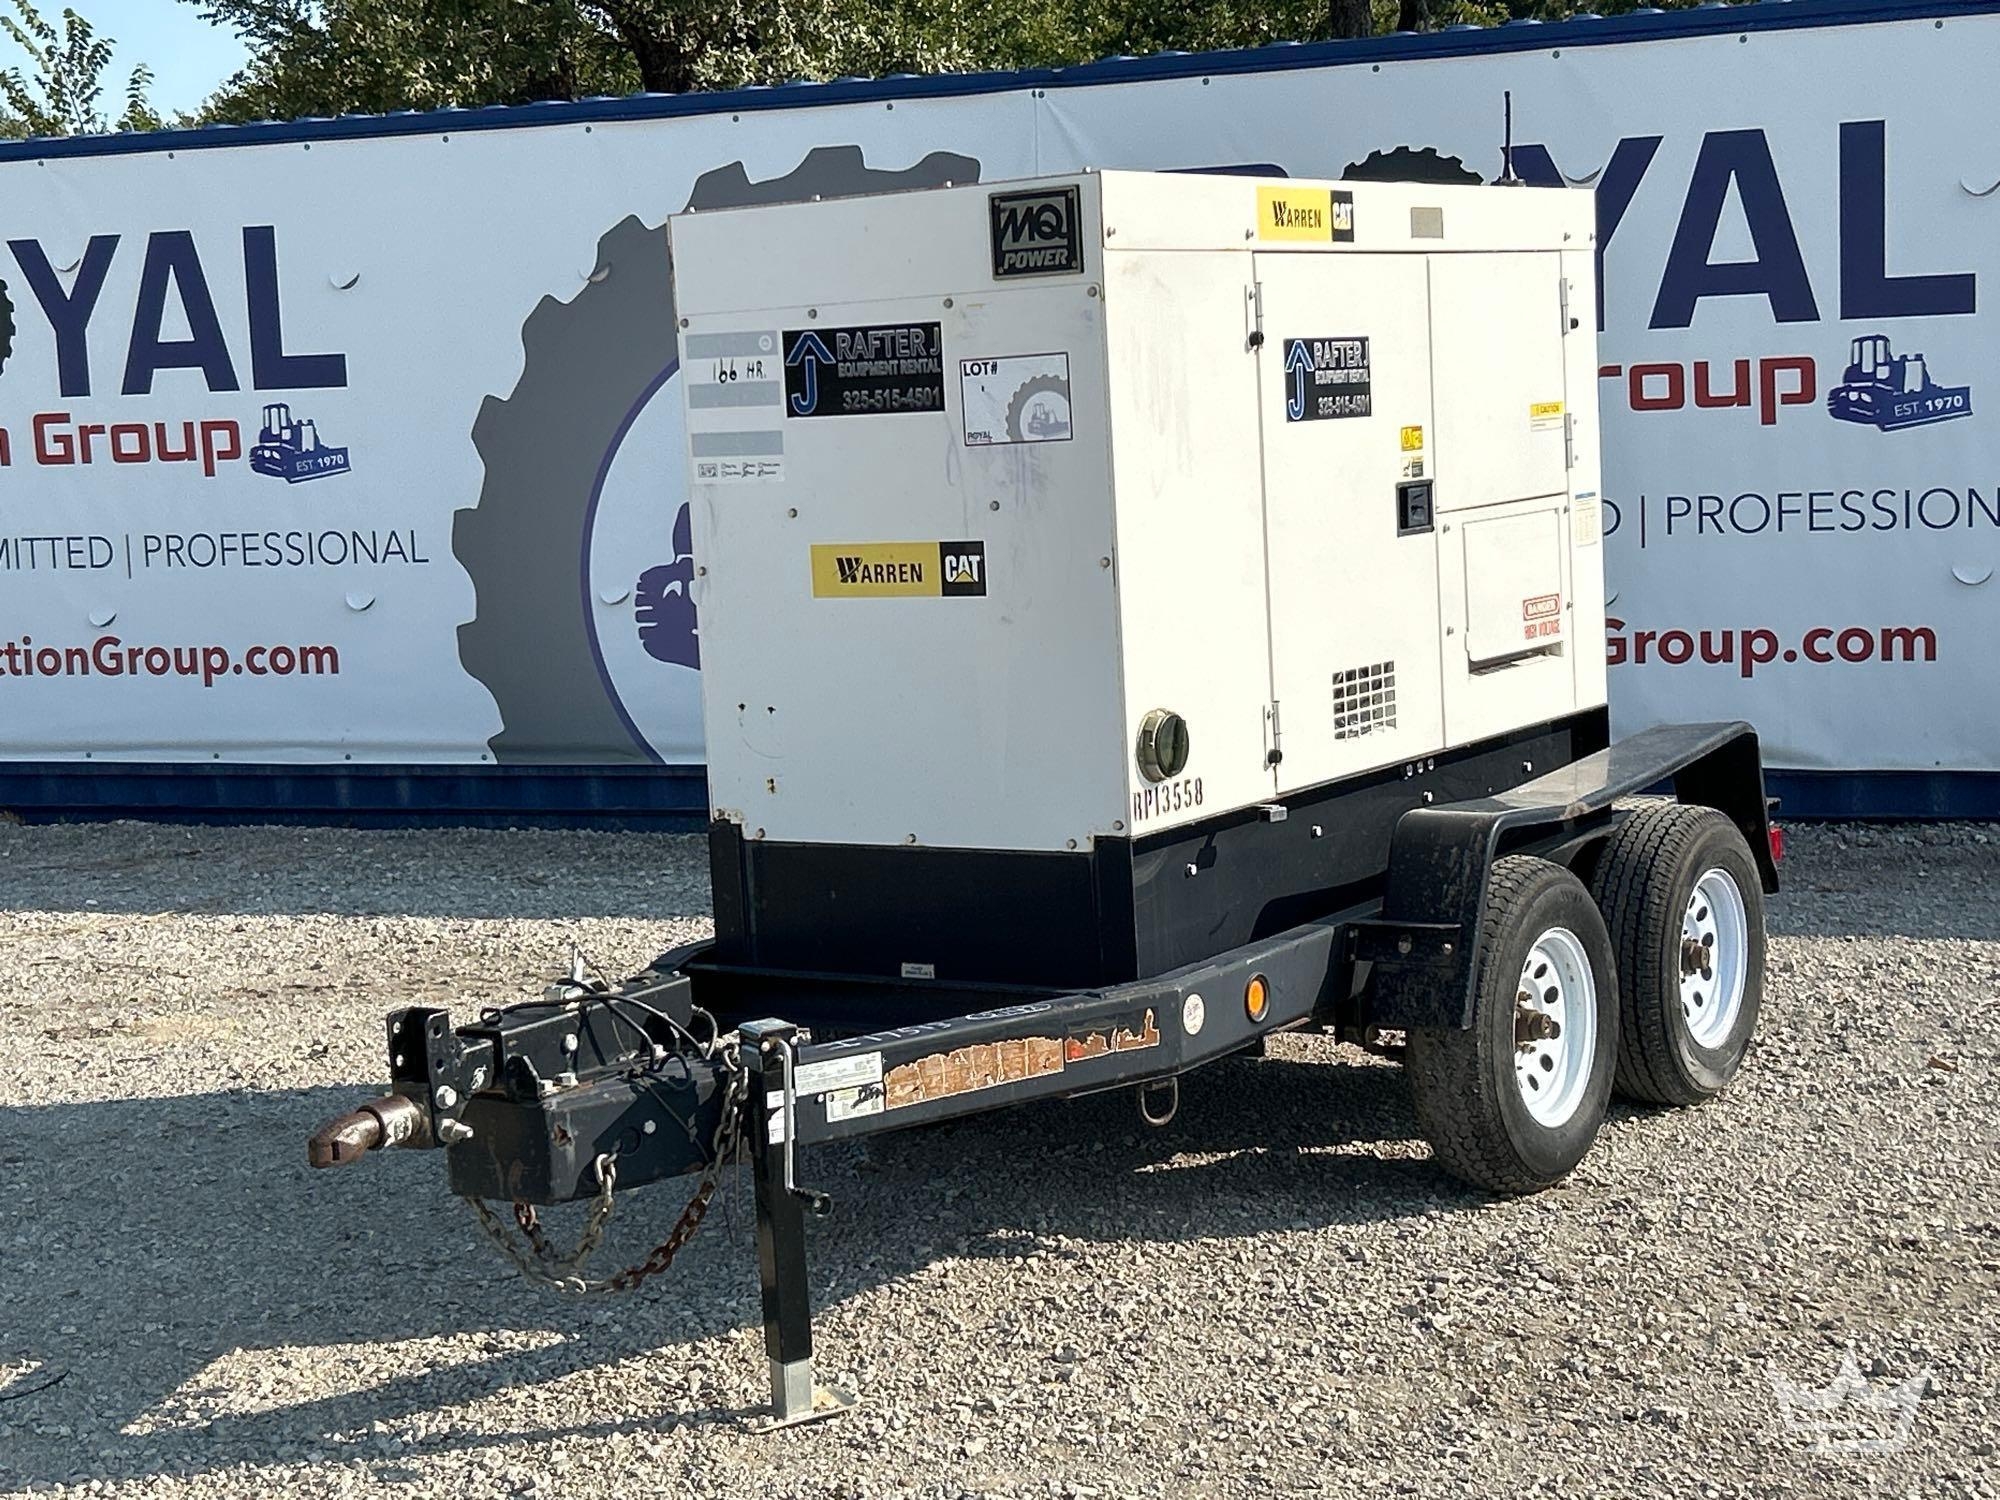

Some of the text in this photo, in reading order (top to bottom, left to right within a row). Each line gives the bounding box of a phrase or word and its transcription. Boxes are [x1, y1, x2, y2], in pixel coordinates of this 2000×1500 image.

[999, 203, 1067, 243] MQ
[1272, 200, 1353, 230] WARREN CAT
[1003, 248, 1068, 270] POWER
[0, 225, 347, 397] YAL
[836, 326, 941, 360] RAFTER J
[1313, 340, 1363, 368] RAFTER
[713, 357, 737, 384] 166
[838, 358, 942, 378] EQUIPMENT RENTAL
[842, 385, 941, 410] 325-515-4501
[1925, 395, 1963, 412] 1970
[32, 412, 242, 477] Group
[967, 430, 993, 440] ROYAL
[317, 454, 344, 468] 1970
[1667, 487, 2000, 535] PROFESSION
[144, 529, 430, 569] PROFESSIONAL
[836, 554, 981, 583] WARREN CAT
